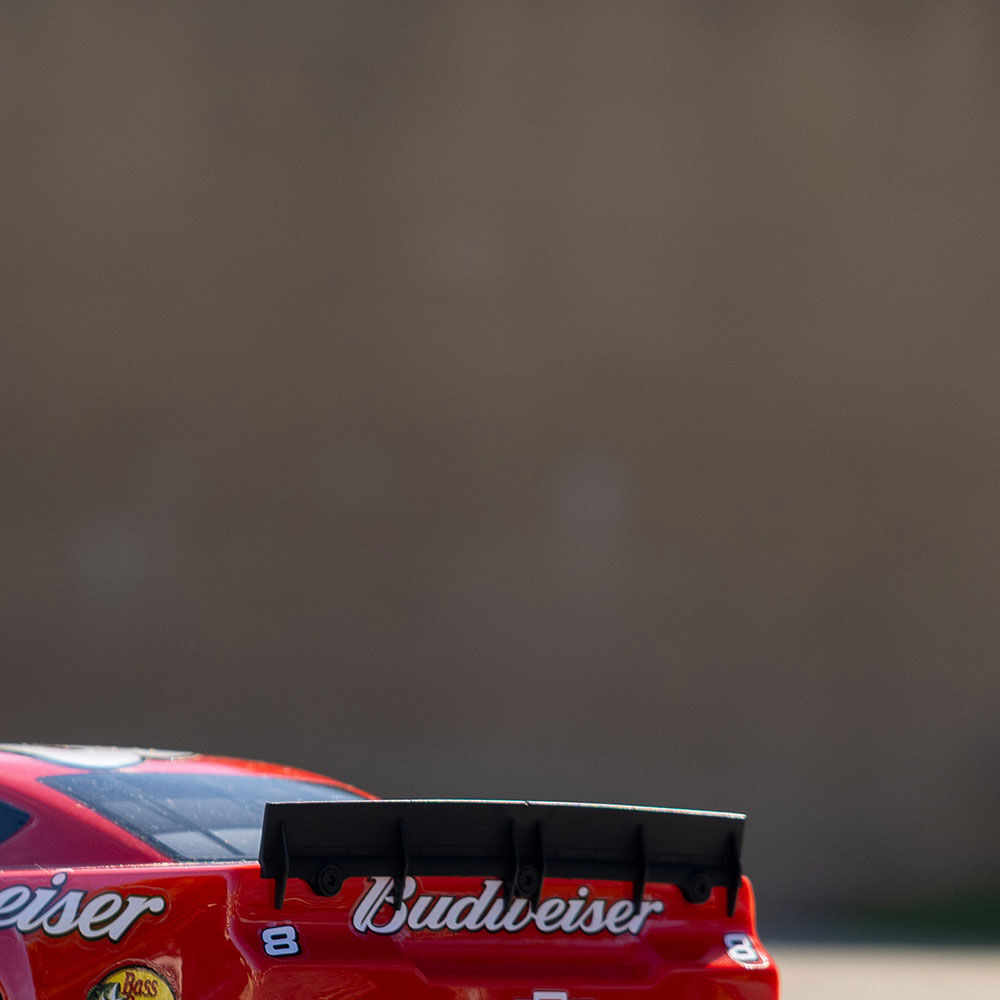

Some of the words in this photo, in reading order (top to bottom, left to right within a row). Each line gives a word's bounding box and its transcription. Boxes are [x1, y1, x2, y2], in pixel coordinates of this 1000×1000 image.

[262, 925, 300, 957] 8
[723, 932, 761, 963] 8
[121, 971, 159, 998] Bass
